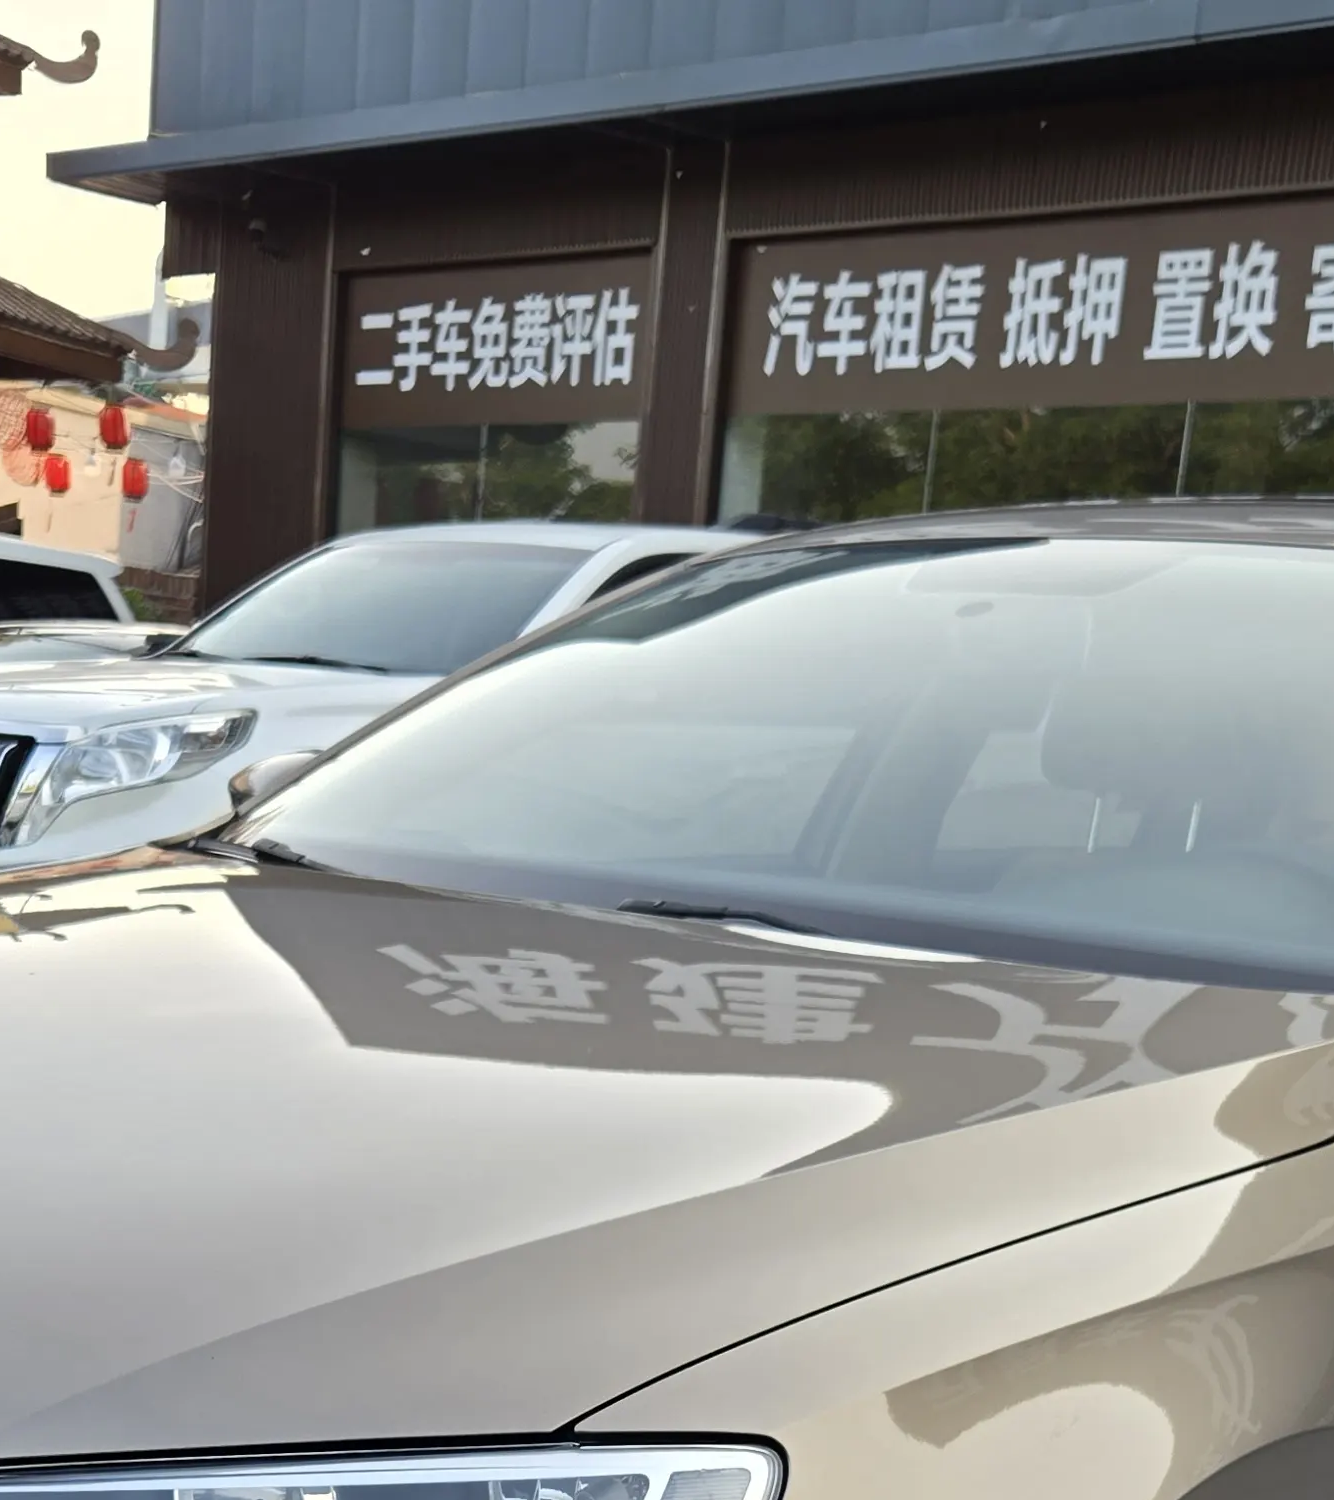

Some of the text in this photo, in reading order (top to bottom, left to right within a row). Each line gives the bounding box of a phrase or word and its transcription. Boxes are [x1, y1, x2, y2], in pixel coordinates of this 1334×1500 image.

[355, 287, 640, 392] 二手车免费评估
[763, 263, 985, 377] 汽车租赁
[999, 253, 1128, 369] 抵押
[1142, 240, 1279, 361] 置换
